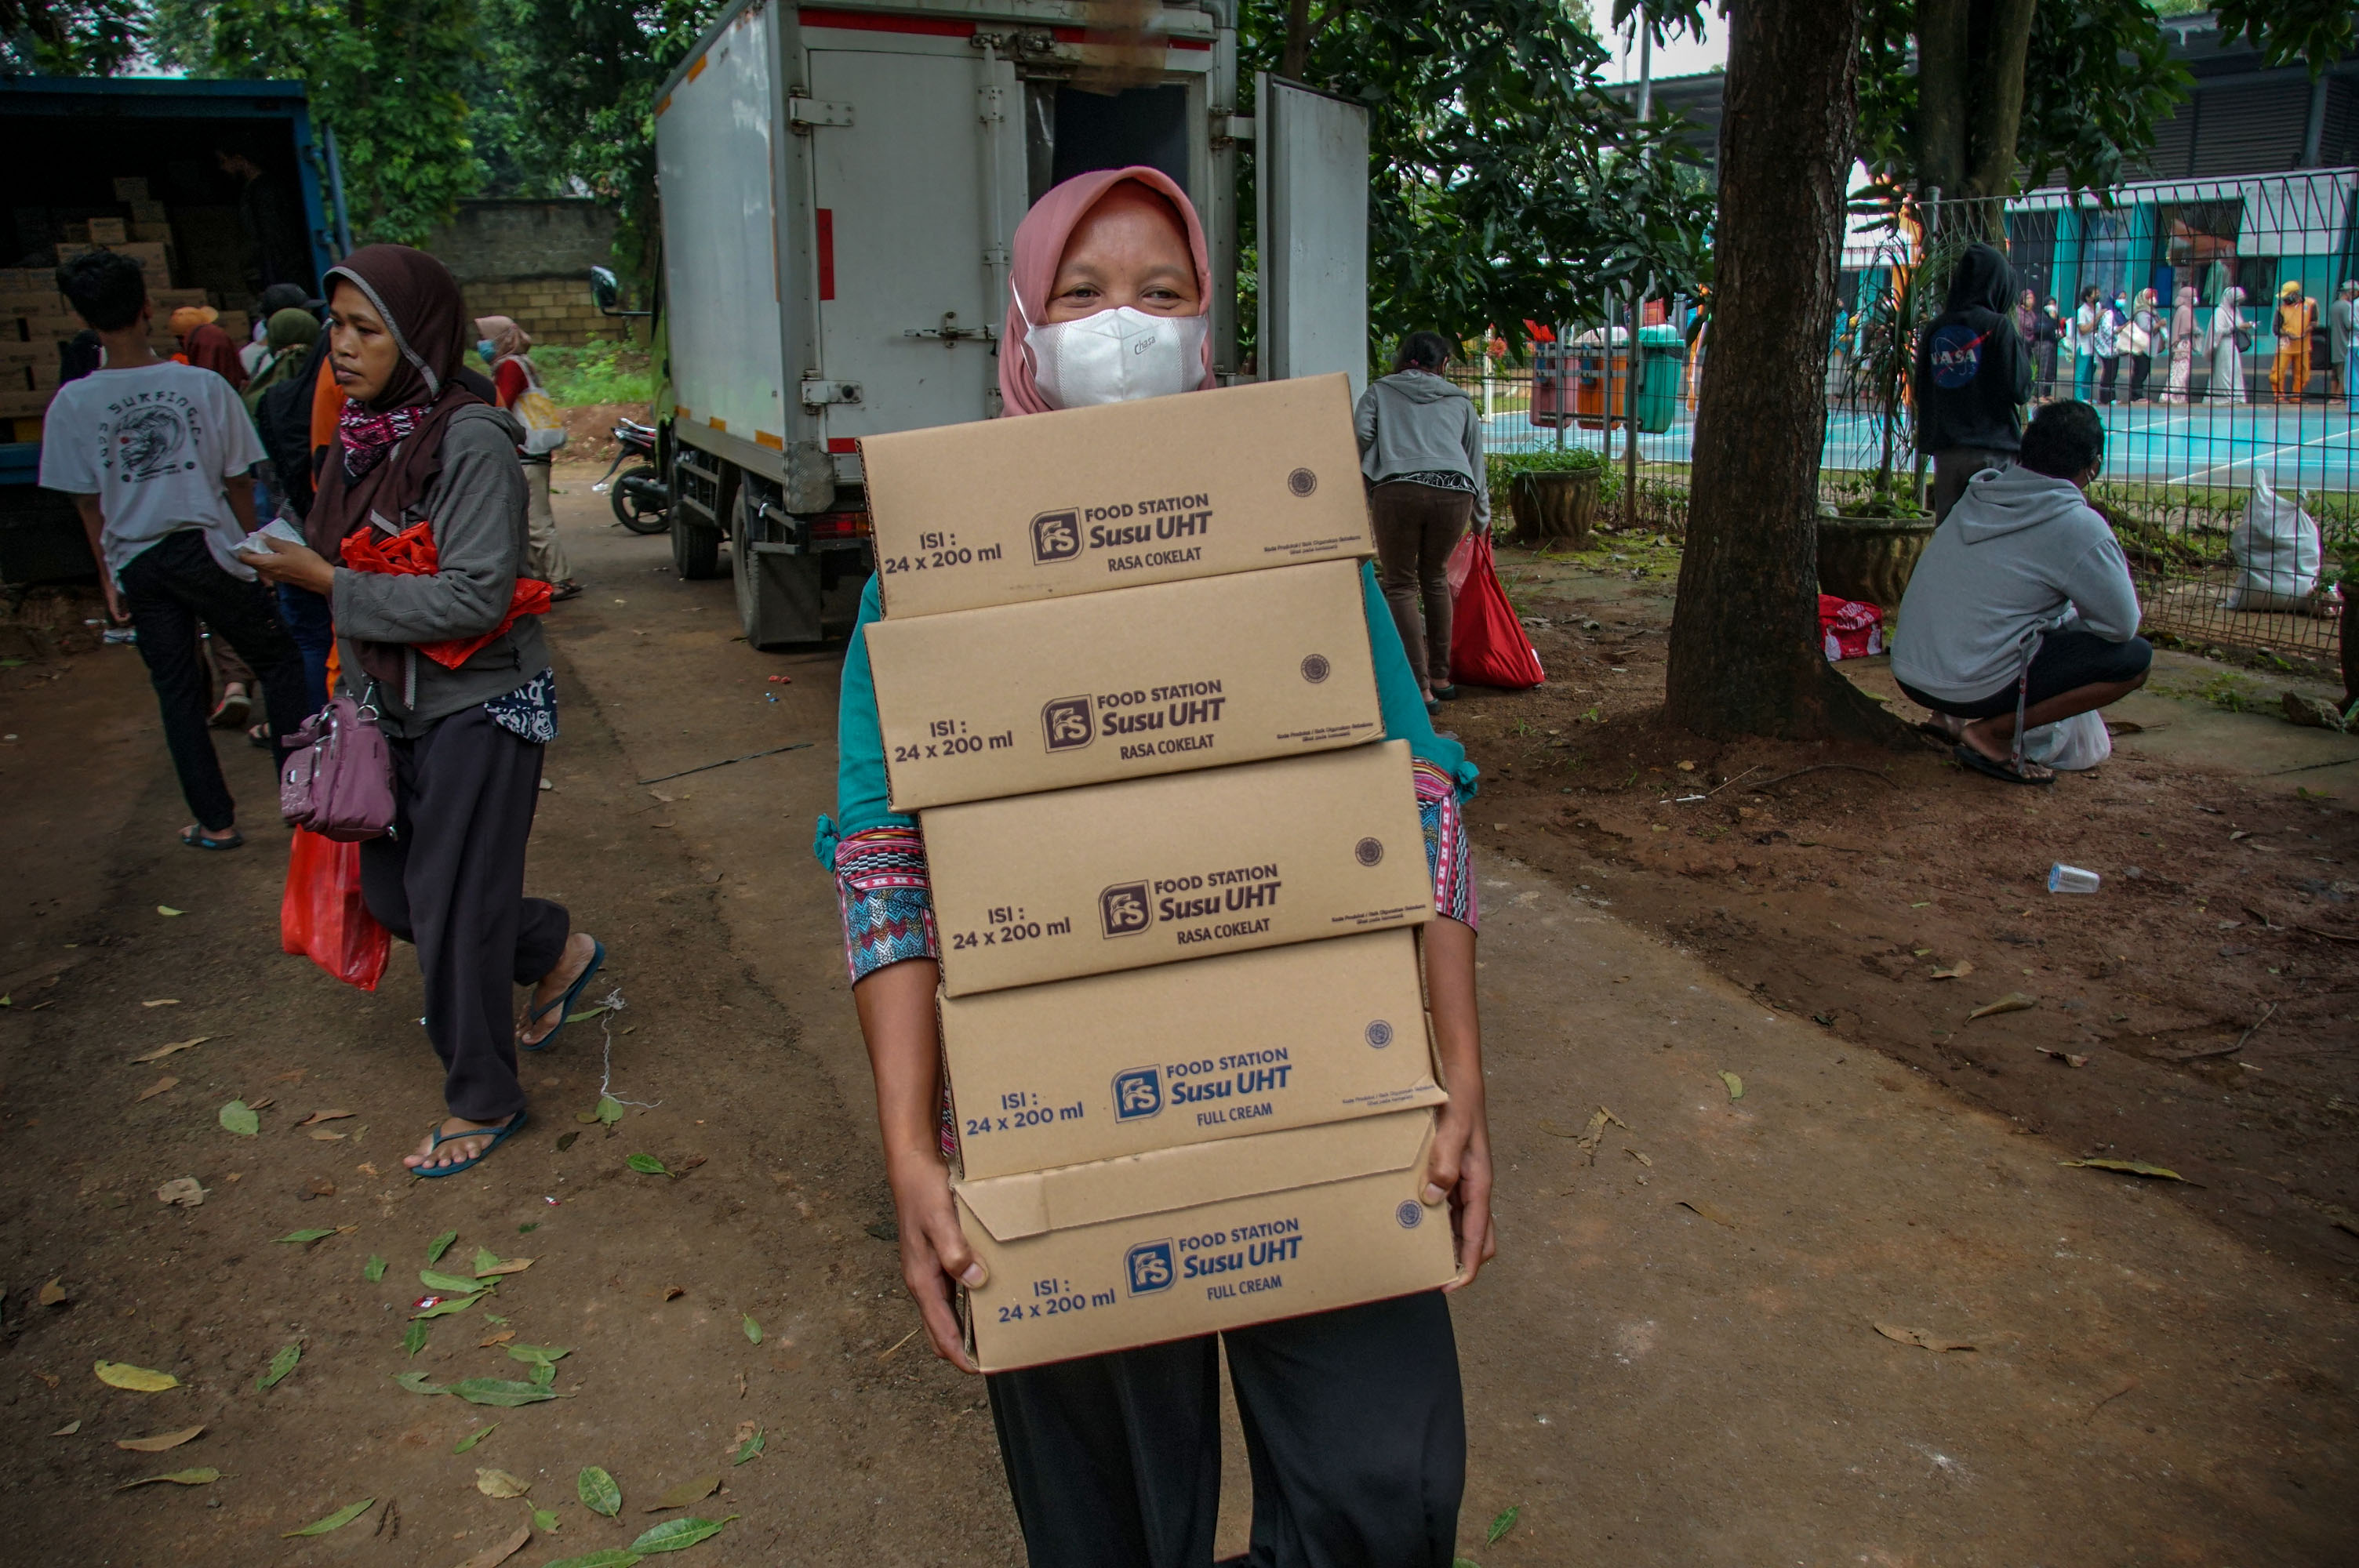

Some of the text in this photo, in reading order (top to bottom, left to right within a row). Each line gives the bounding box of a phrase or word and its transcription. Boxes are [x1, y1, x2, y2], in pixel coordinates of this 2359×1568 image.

[1134, 336, 1156, 355] Chasa
[1931, 349, 1976, 365] NASA
[1085, 493, 1209, 522] FOOD STATION
[1089, 510, 1212, 548] Susu UHT
[885, 543, 1001, 574] 24 x 200 ml
[1108, 546, 1201, 572] RASA COKELAT
[1097, 680, 1222, 709] FOOD STATION
[1102, 697, 1226, 735] Susu UHT
[895, 730, 1012, 762] 24 x 200 ml
[1120, 734, 1214, 760] RASA COKELAT
[1154, 863, 1278, 895] FOOD STATION
[1159, 881, 1281, 921] Susu UHT
[953, 916, 1070, 949] 24 x 200 ml
[1177, 918, 1270, 945] RASA COKELAT
[1166, 1047, 1288, 1078] FOOD STATION
[1171, 1065, 1292, 1105] Susu UHT
[966, 1101, 1083, 1135] 24 x 200 ml
[1197, 1102, 1272, 1126] FULL CREAM
[1179, 1218, 1299, 1251] FOOD STATION
[1183, 1236, 1303, 1278] Susu UHT
[1208, 1275, 1282, 1300] FULL CREAM
[998, 1288, 1115, 1323] 24 x 200 ml
